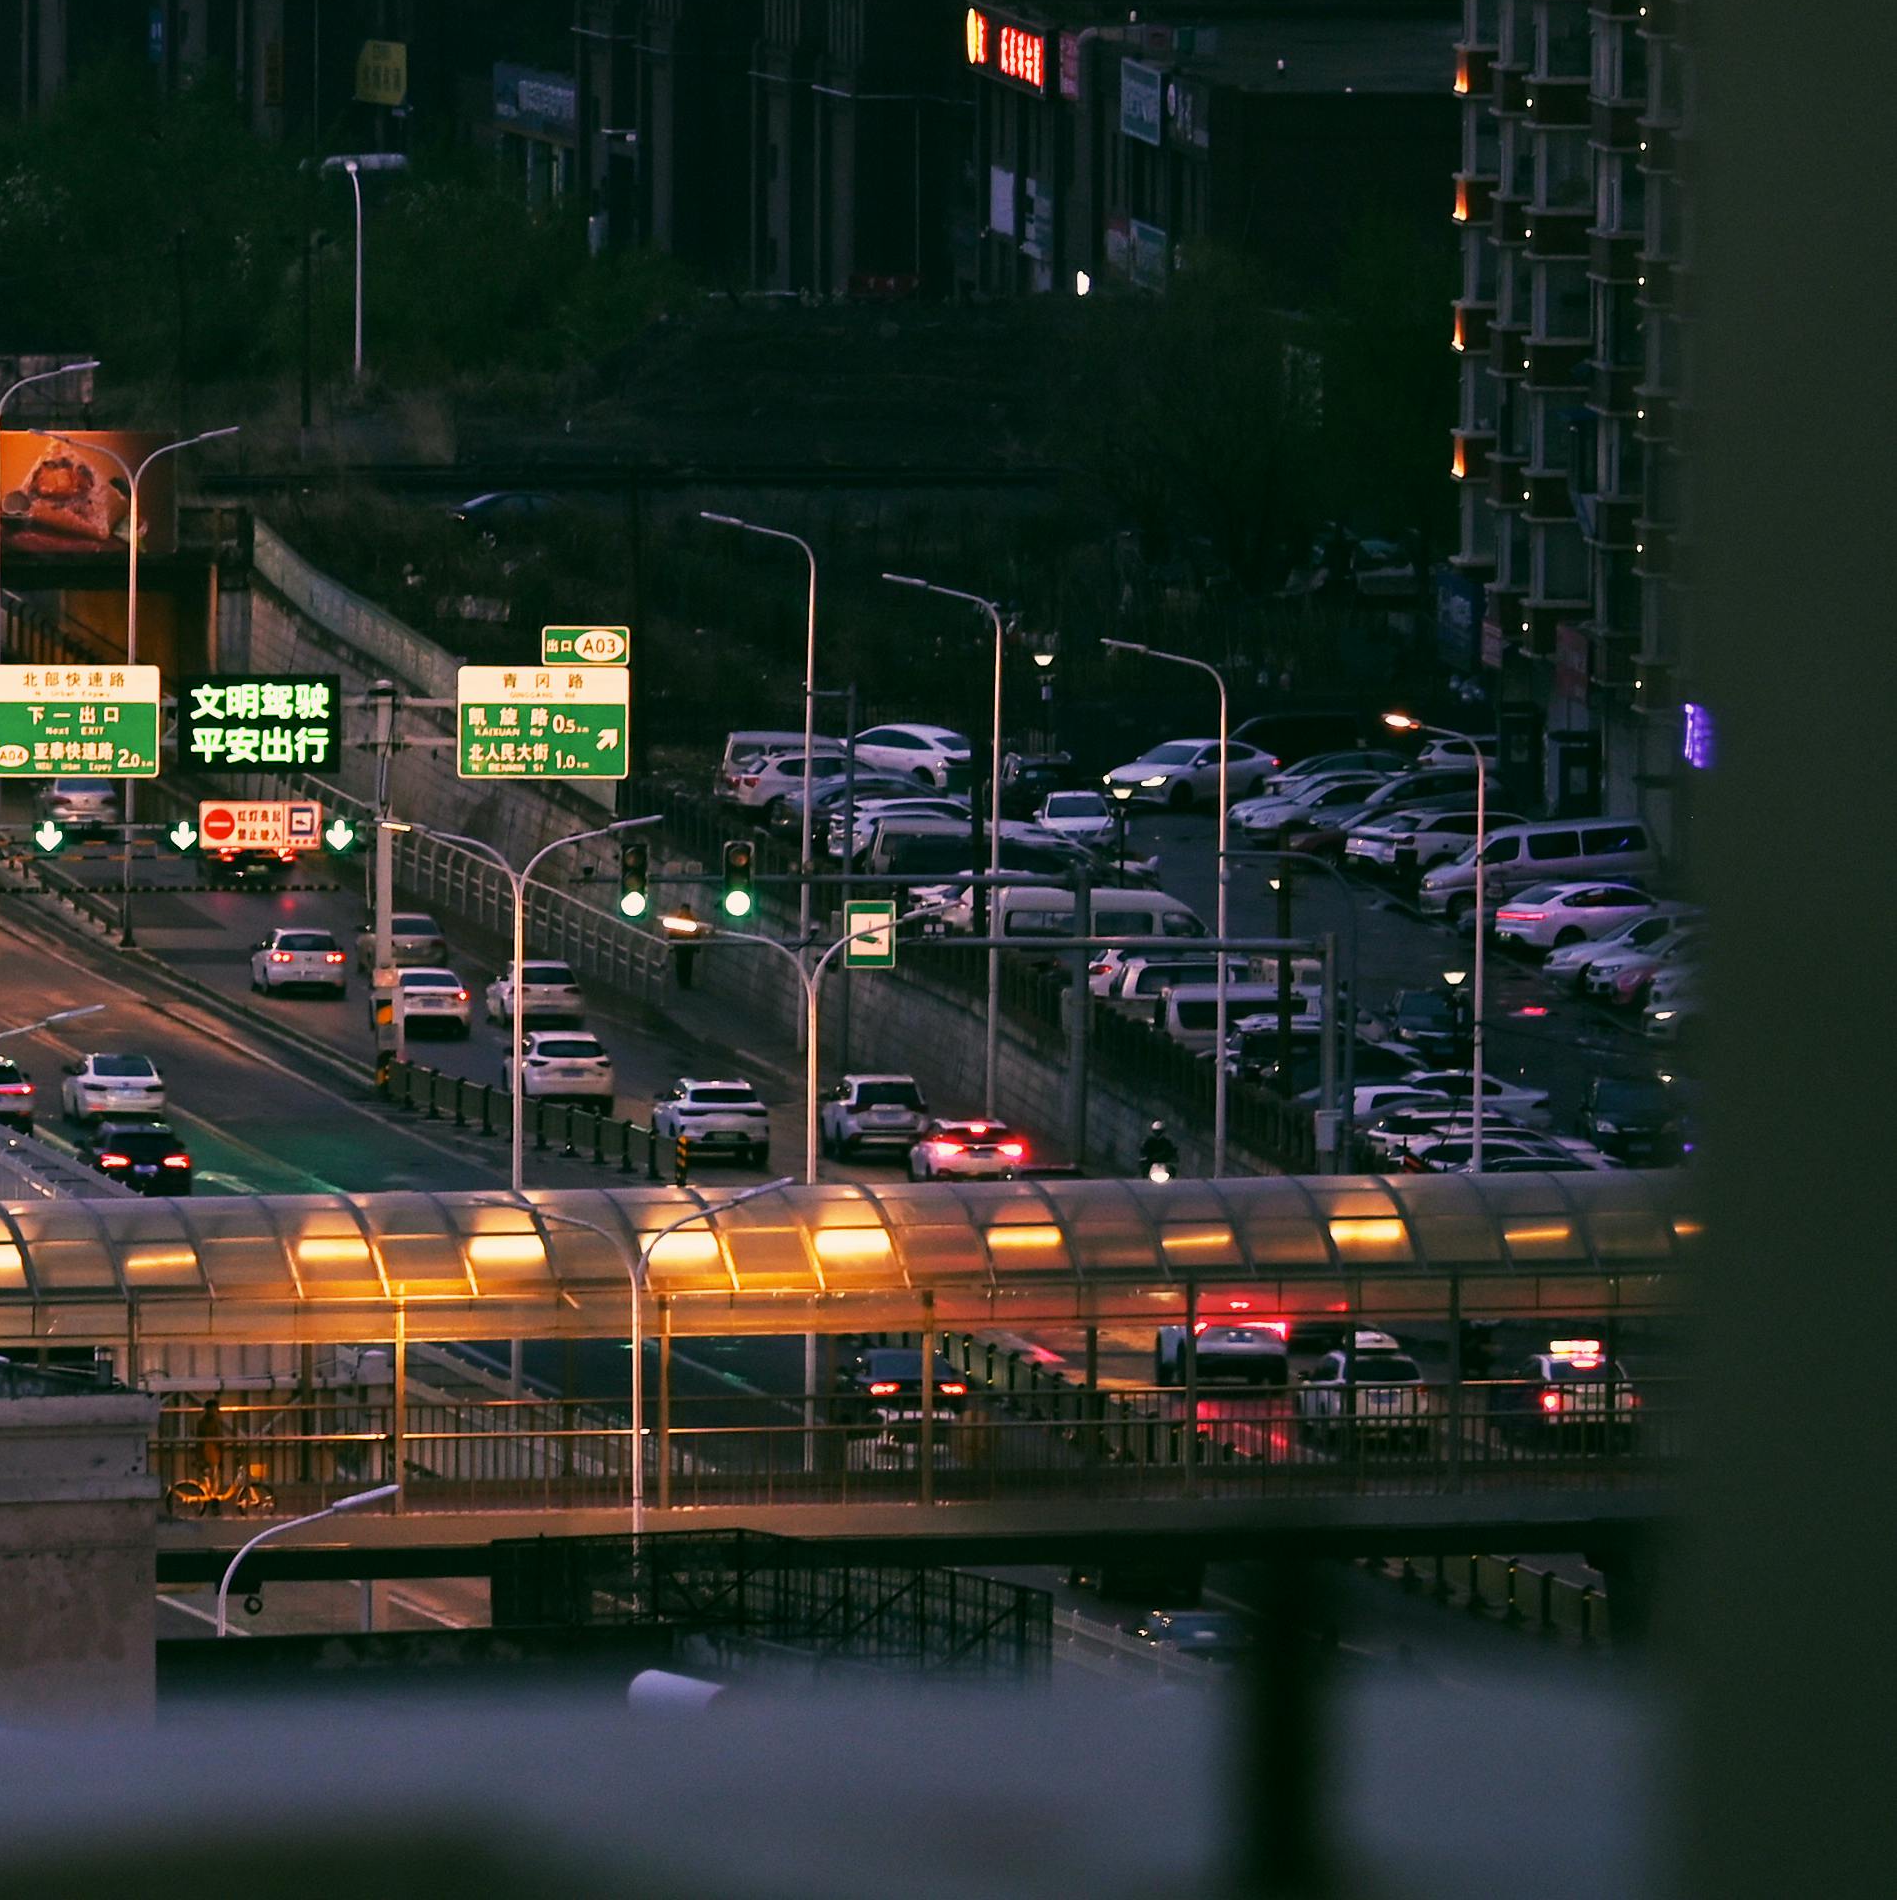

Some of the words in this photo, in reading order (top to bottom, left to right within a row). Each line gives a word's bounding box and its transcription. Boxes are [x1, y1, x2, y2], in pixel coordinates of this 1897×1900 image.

[546, 638, 573, 653] 出口
[582, 638, 616, 654] A03
[23, 671, 126, 688] 北部快速路
[503, 672, 584, 689] 青冈路
[189, 682, 330, 720] 文明驾驶
[27, 705, 120, 726] 下一出口
[468, 706, 549, 727] 凯旋路
[45, 726, 70, 736] Next
[80, 726, 105, 736] EXIT
[474, 727, 521, 737] KAIXUAN
[33, 741, 114, 761] 亚泰快速路
[190, 726, 330, 764] 平安出行
[468, 742, 549, 762] 北人民大街
[0, 750, 24, 762] A04
[488, 763, 526, 773] RENMIN
[237, 828, 282, 842] 禁止驶入
